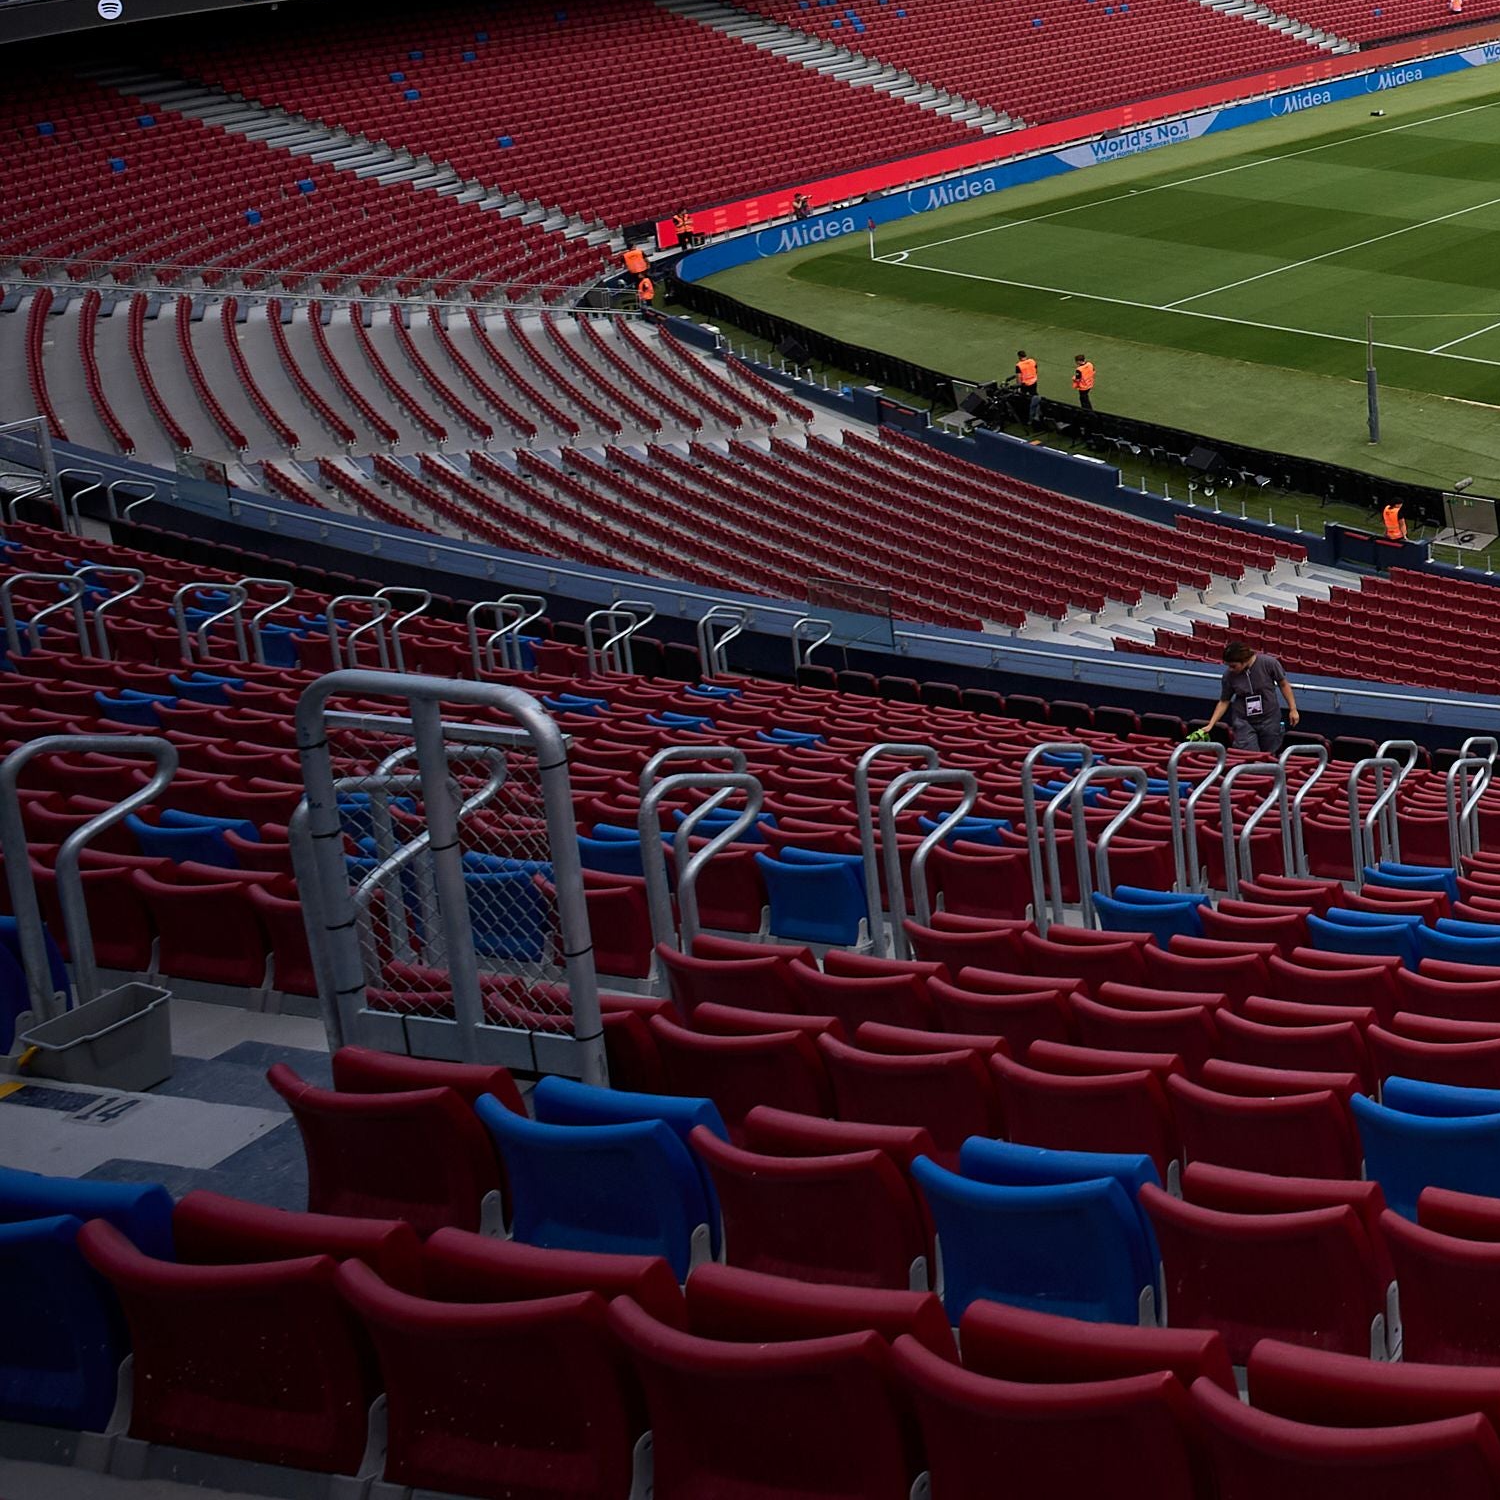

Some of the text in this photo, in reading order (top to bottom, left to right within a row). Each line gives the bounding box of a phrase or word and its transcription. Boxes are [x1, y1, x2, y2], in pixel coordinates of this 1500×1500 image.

[1378, 68, 1423, 90] Midea
[1282, 90, 1332, 114] Midea
[1090, 120, 1189, 157] World's No.1
[1096, 133, 1190, 163] Smart Home Appliances Brand
[925, 178, 996, 210] Midea
[775, 215, 855, 251] Midea
[73, 1097, 141, 1122] 14
